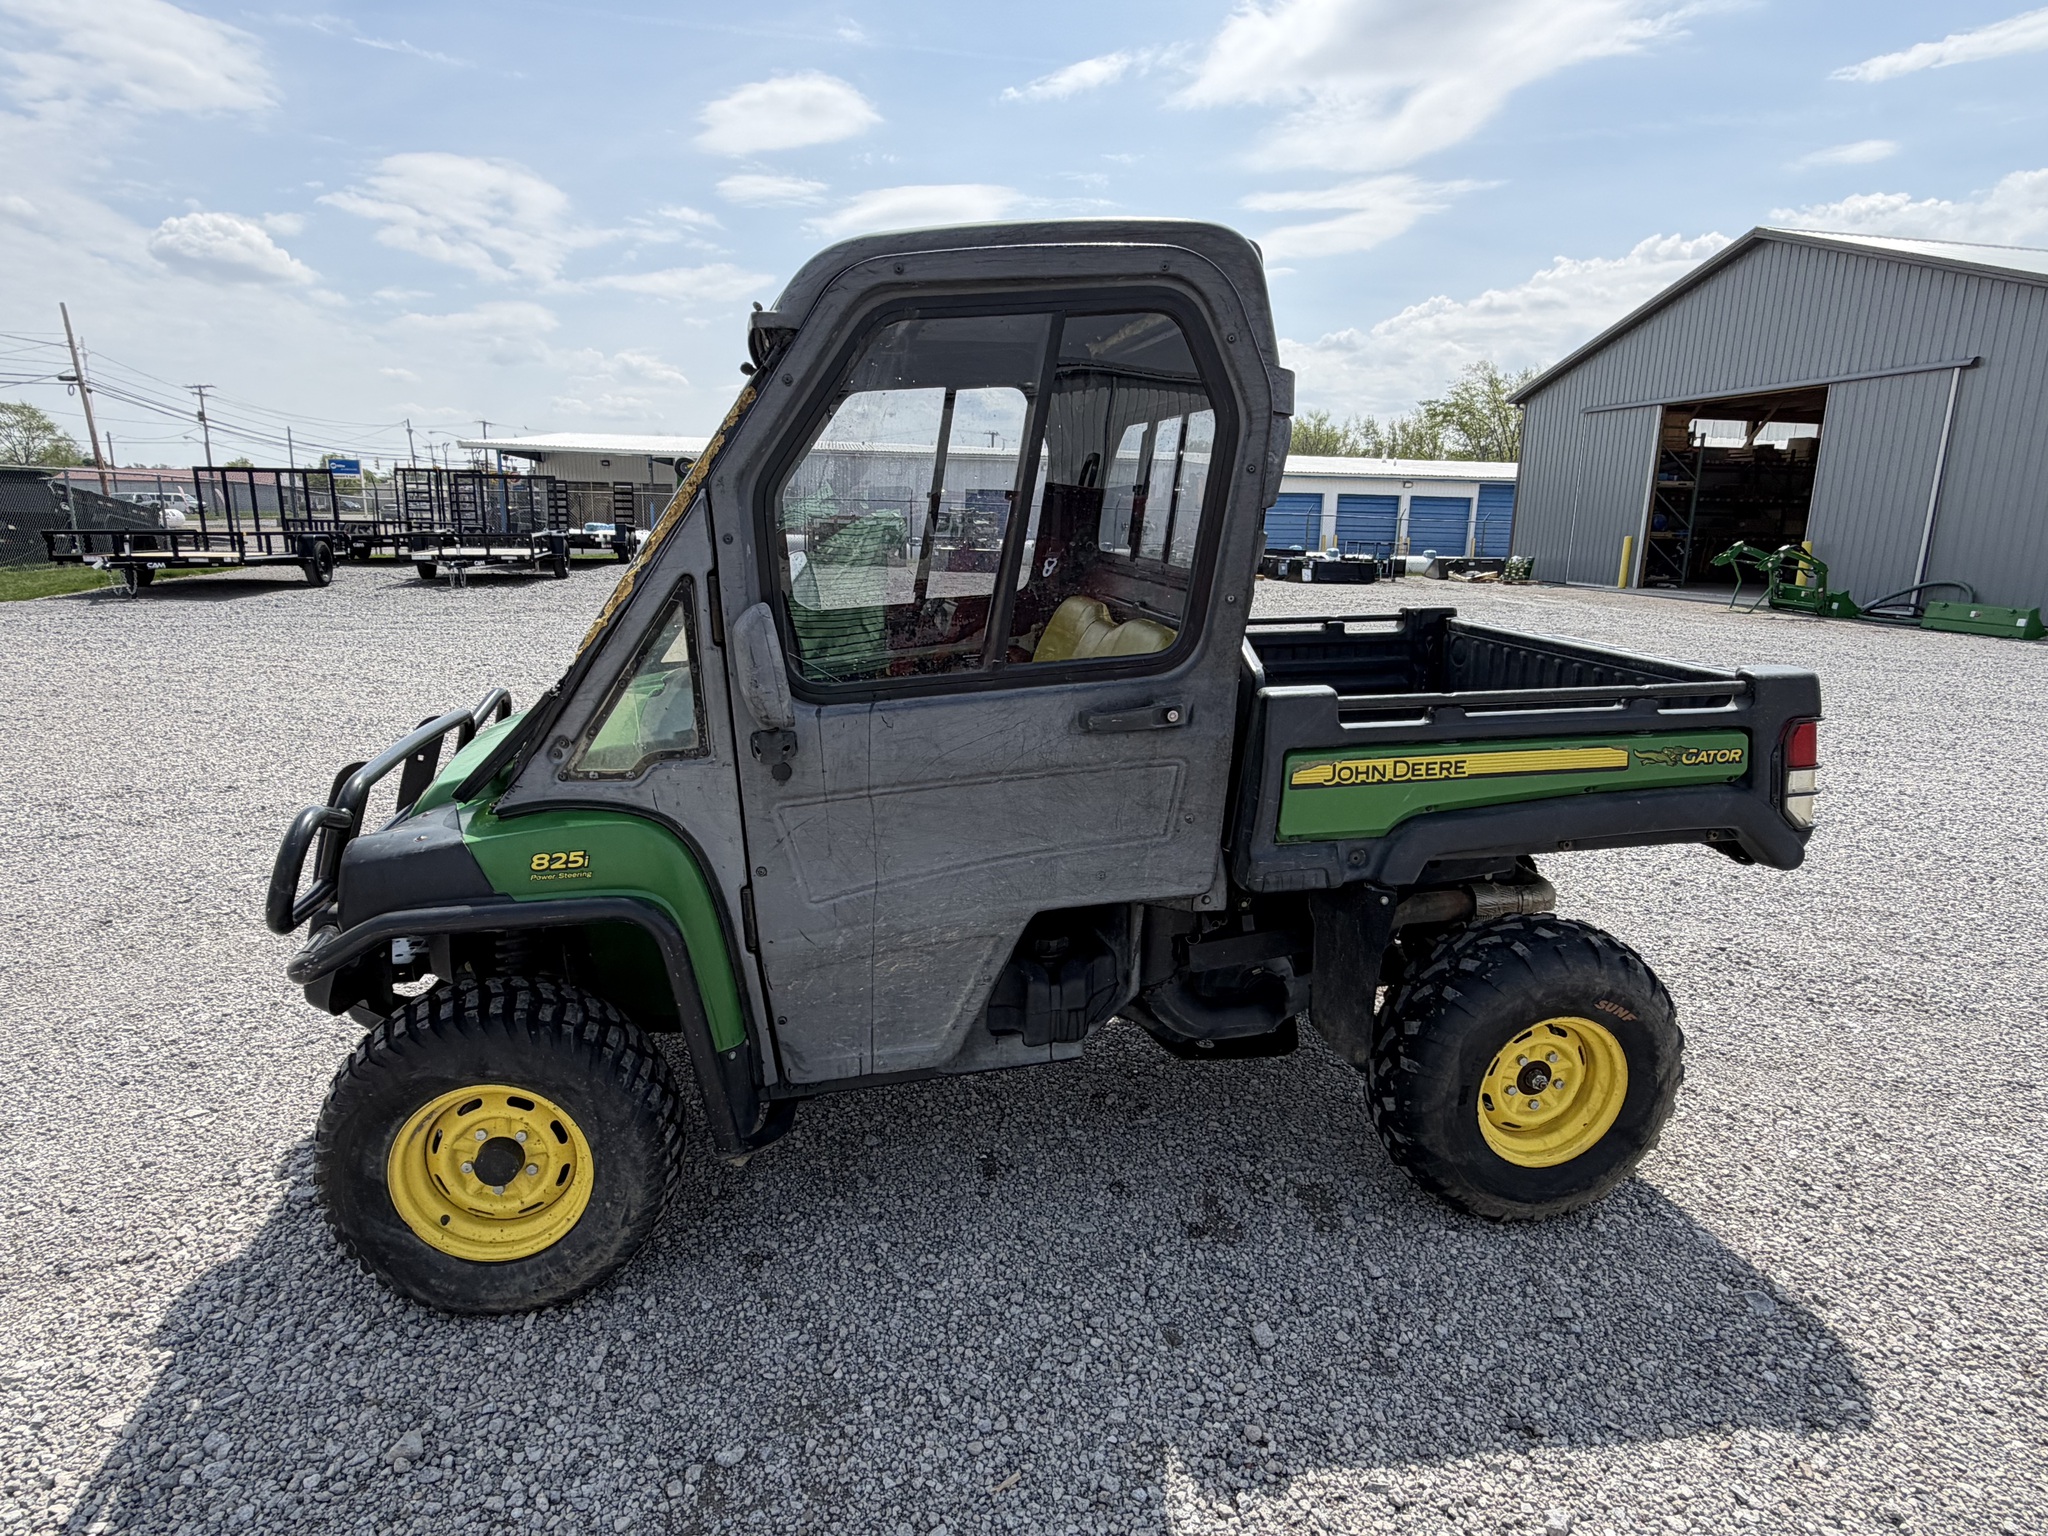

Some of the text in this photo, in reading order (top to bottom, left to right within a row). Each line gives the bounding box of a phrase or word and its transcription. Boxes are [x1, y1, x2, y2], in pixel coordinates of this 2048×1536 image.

[1681, 748, 1742, 765] GATOR
[1323, 760, 1467, 783] JOHN DEERE
[530, 850, 590, 871] 825i
[530, 871, 592, 881] Power Steering
